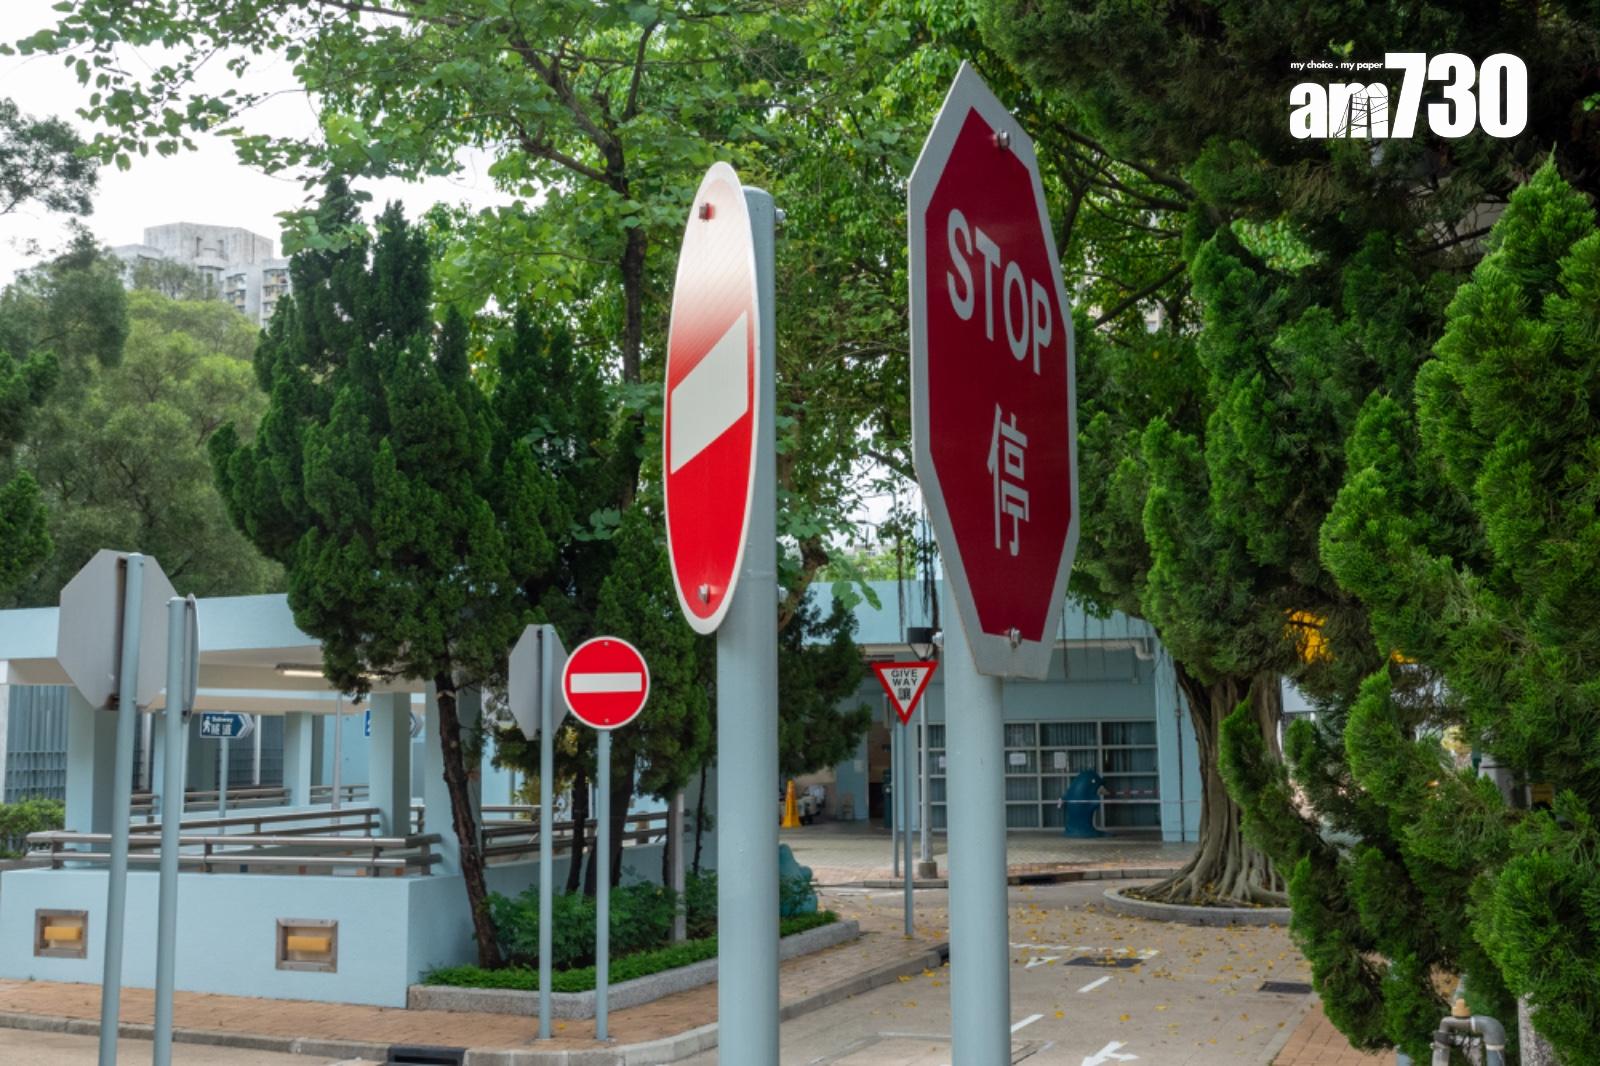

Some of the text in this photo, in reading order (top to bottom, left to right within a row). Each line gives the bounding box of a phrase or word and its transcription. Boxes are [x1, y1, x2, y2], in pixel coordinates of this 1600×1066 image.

[947, 208, 1052, 375] STOP
[986, 403, 1029, 557] 停
[891, 669, 918, 677] GIVE
[892, 678, 918, 686] WAY
